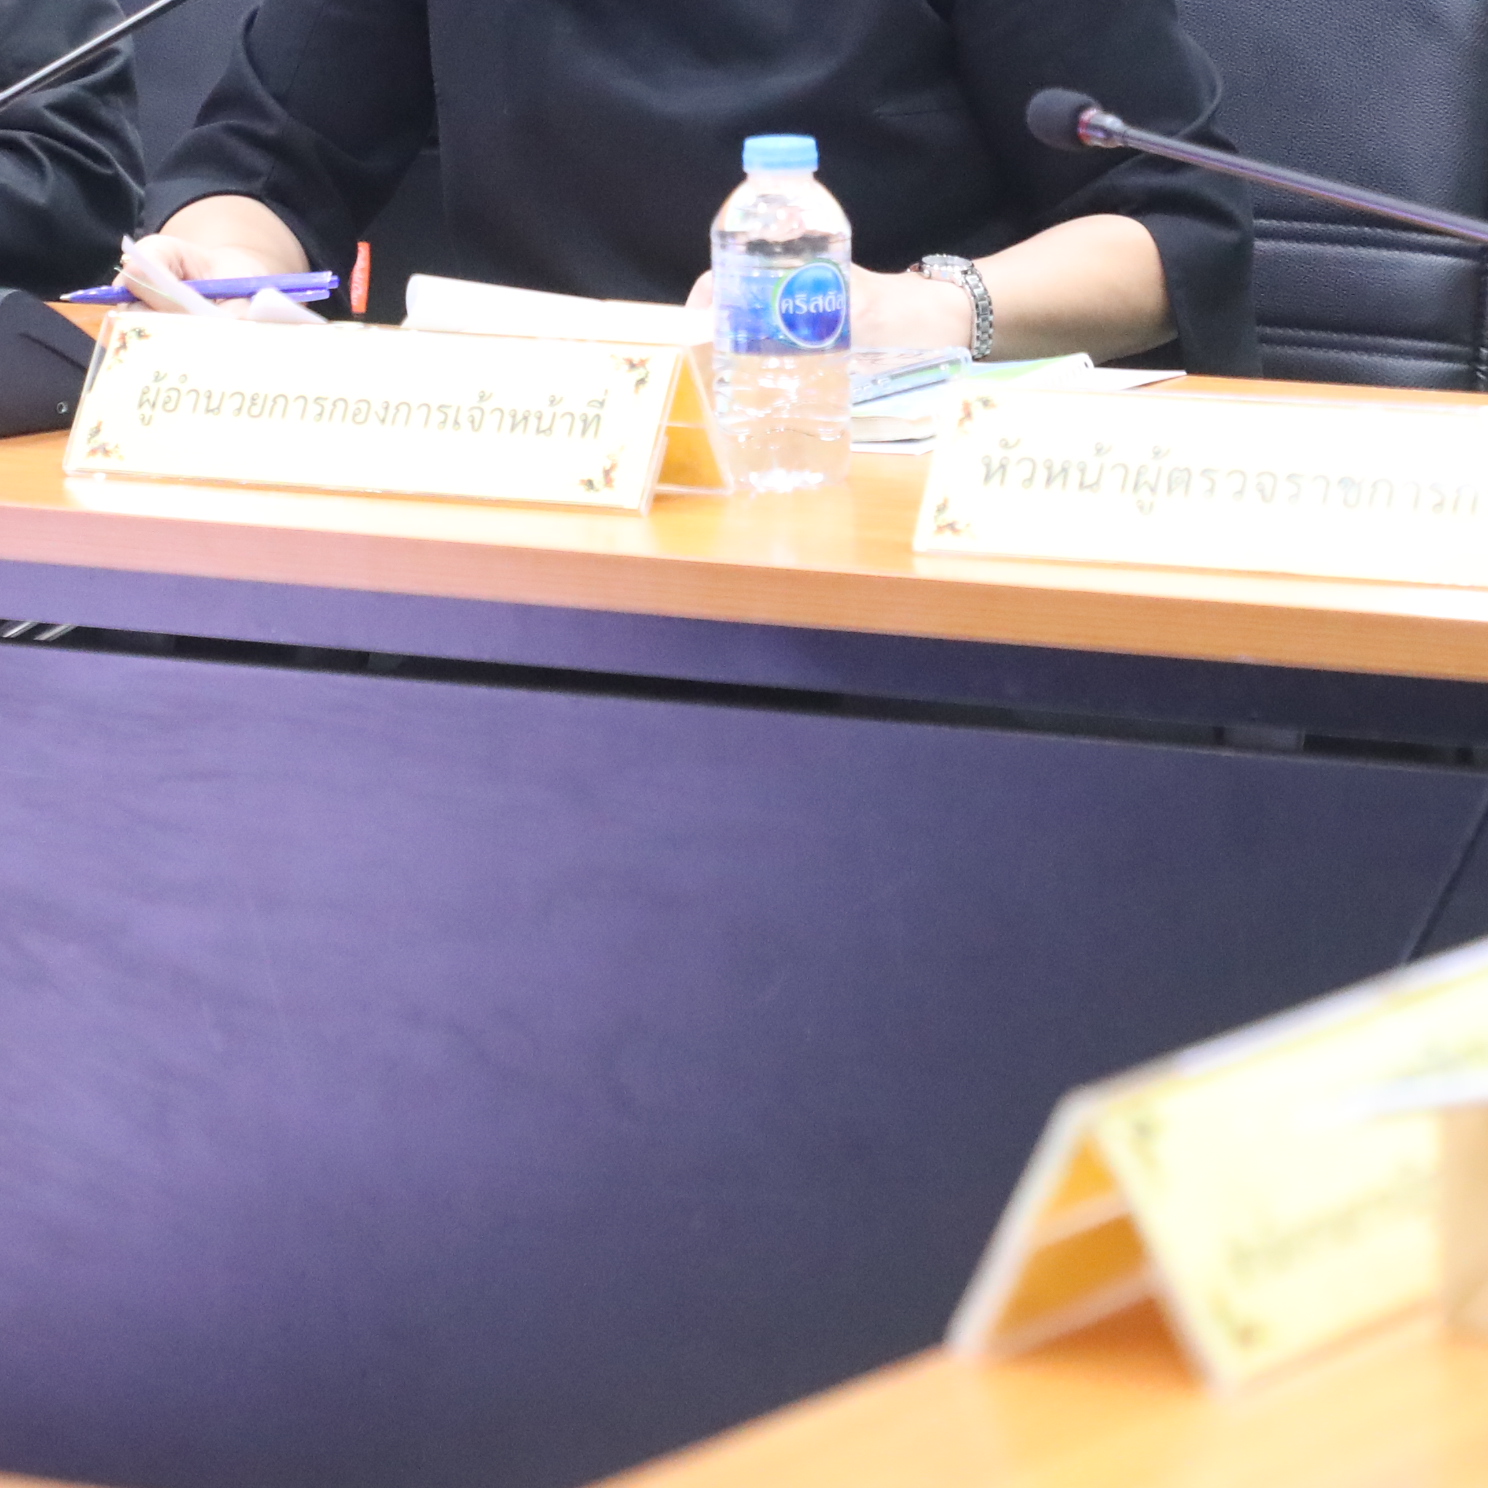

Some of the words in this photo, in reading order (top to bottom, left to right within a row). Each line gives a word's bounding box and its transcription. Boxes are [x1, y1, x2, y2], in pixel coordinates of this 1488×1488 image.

[137, 369, 610, 441] ผู้อำนวยการกองการเจ้าหน้าที่
